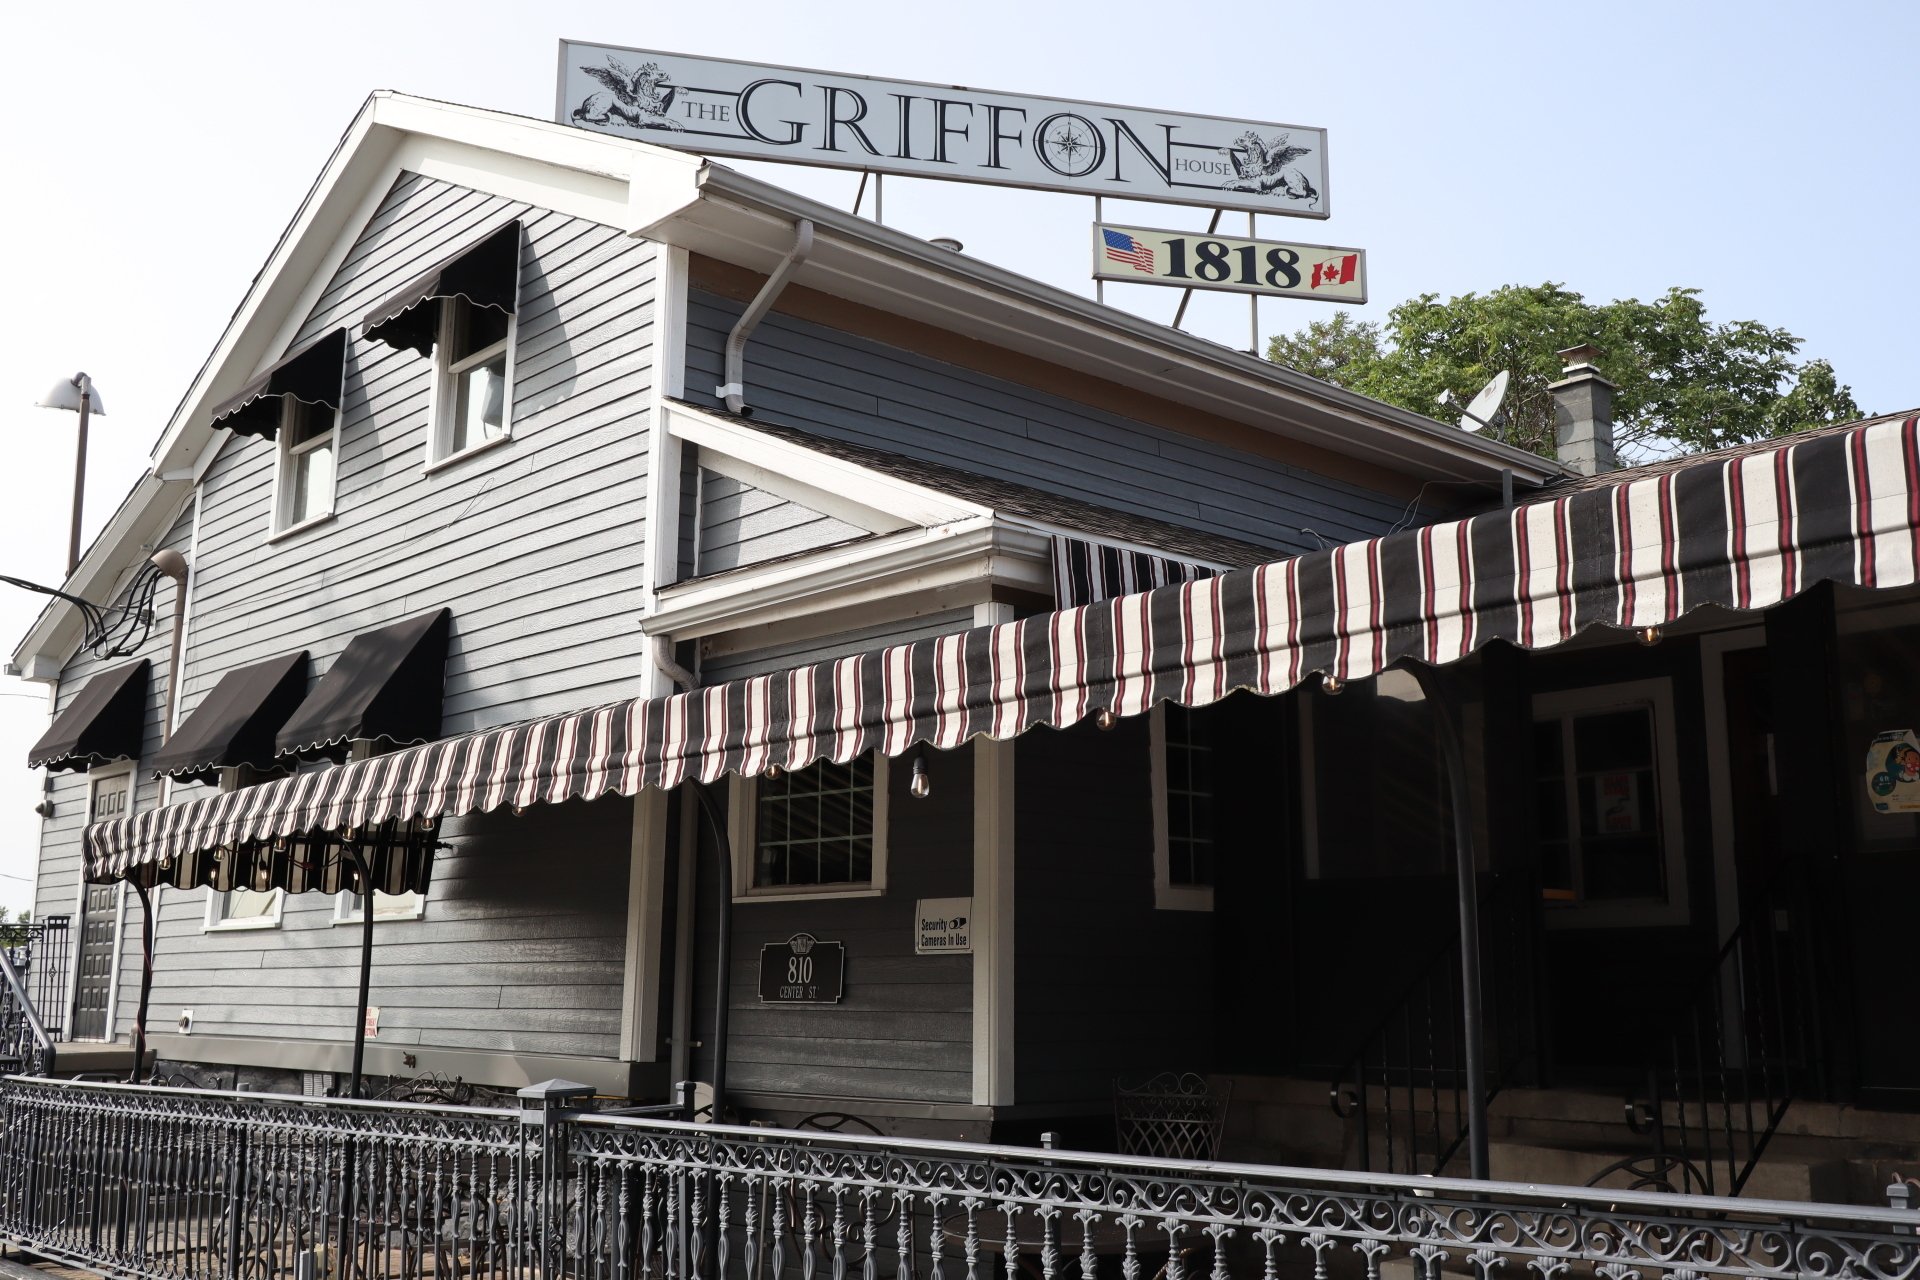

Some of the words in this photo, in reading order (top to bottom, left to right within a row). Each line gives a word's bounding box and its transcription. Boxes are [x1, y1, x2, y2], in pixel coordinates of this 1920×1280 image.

[681, 101, 730, 122] THE
[735, 78, 1182, 188] GRIFFON
[1175, 158, 1232, 176] HOUSE
[1161, 238, 1301, 289] 1818
[921, 918, 948, 933] Security
[921, 934, 947, 947] Cameras
[948, 933, 955, 946] In
[955, 933, 967, 946] Use
[787, 956, 813, 984] 810
[779, 985, 804, 999] CENTER
